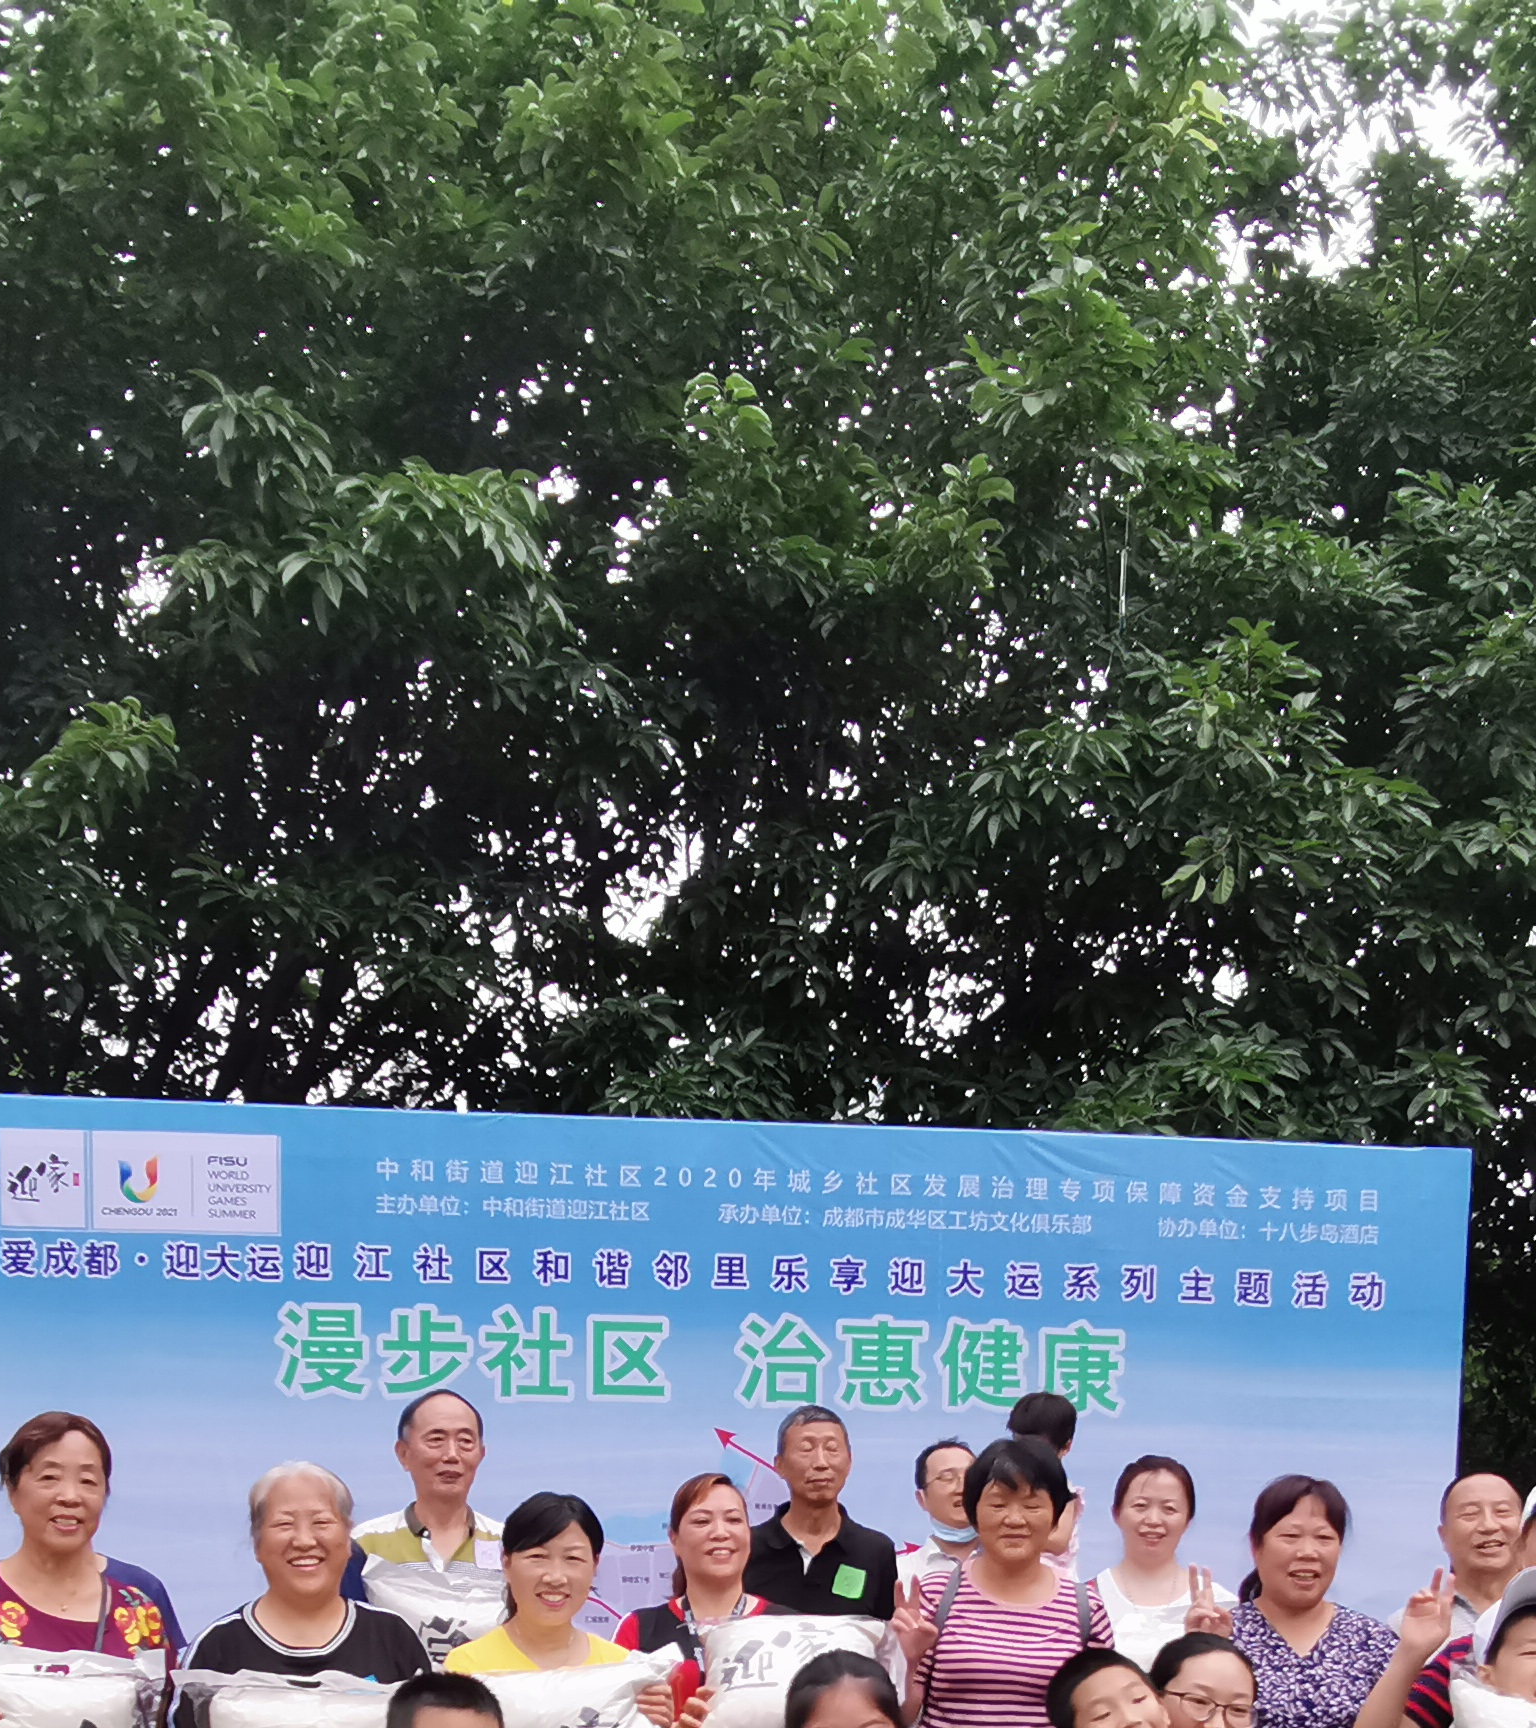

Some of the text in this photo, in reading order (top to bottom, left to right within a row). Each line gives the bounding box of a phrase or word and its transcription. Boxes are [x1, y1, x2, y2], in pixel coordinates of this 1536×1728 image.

[207, 1155, 248, 1167] FISU
[207, 1169, 250, 1181] WORLD
[207, 1182, 272, 1194] UNIVERSITY
[207, 1195, 248, 1207] GAMES
[100, 1205, 179, 1217] CHENGDU 2021
[207, 1208, 257, 1220] SUMMER
[276, 1301, 1127, 1416] 漫步社区 治惠健康
